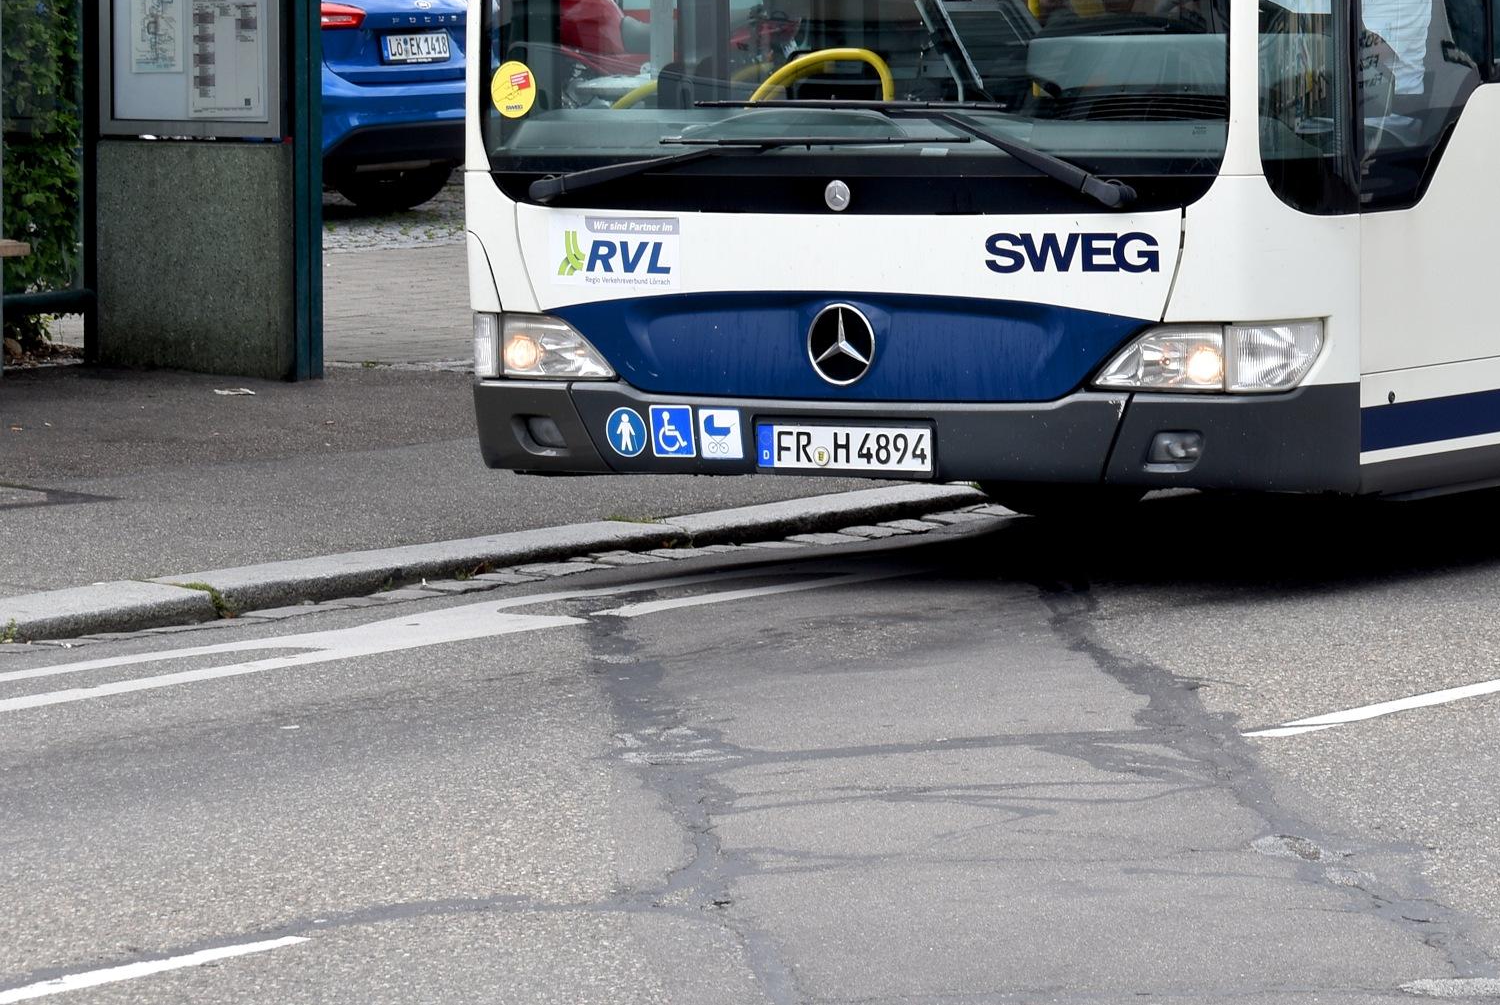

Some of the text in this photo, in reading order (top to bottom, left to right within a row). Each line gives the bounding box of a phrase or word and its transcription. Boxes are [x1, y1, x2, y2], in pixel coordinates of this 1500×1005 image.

[388, 36, 448, 56] LÖ EK 1418
[593, 221, 673, 232] Wir sind Partner im
[585, 239, 671, 275] RVL
[984, 231, 1160, 274] SWEG
[585, 276, 600, 285] Regio
[777, 430, 813, 463] FR
[857, 432, 927, 466] 4894
